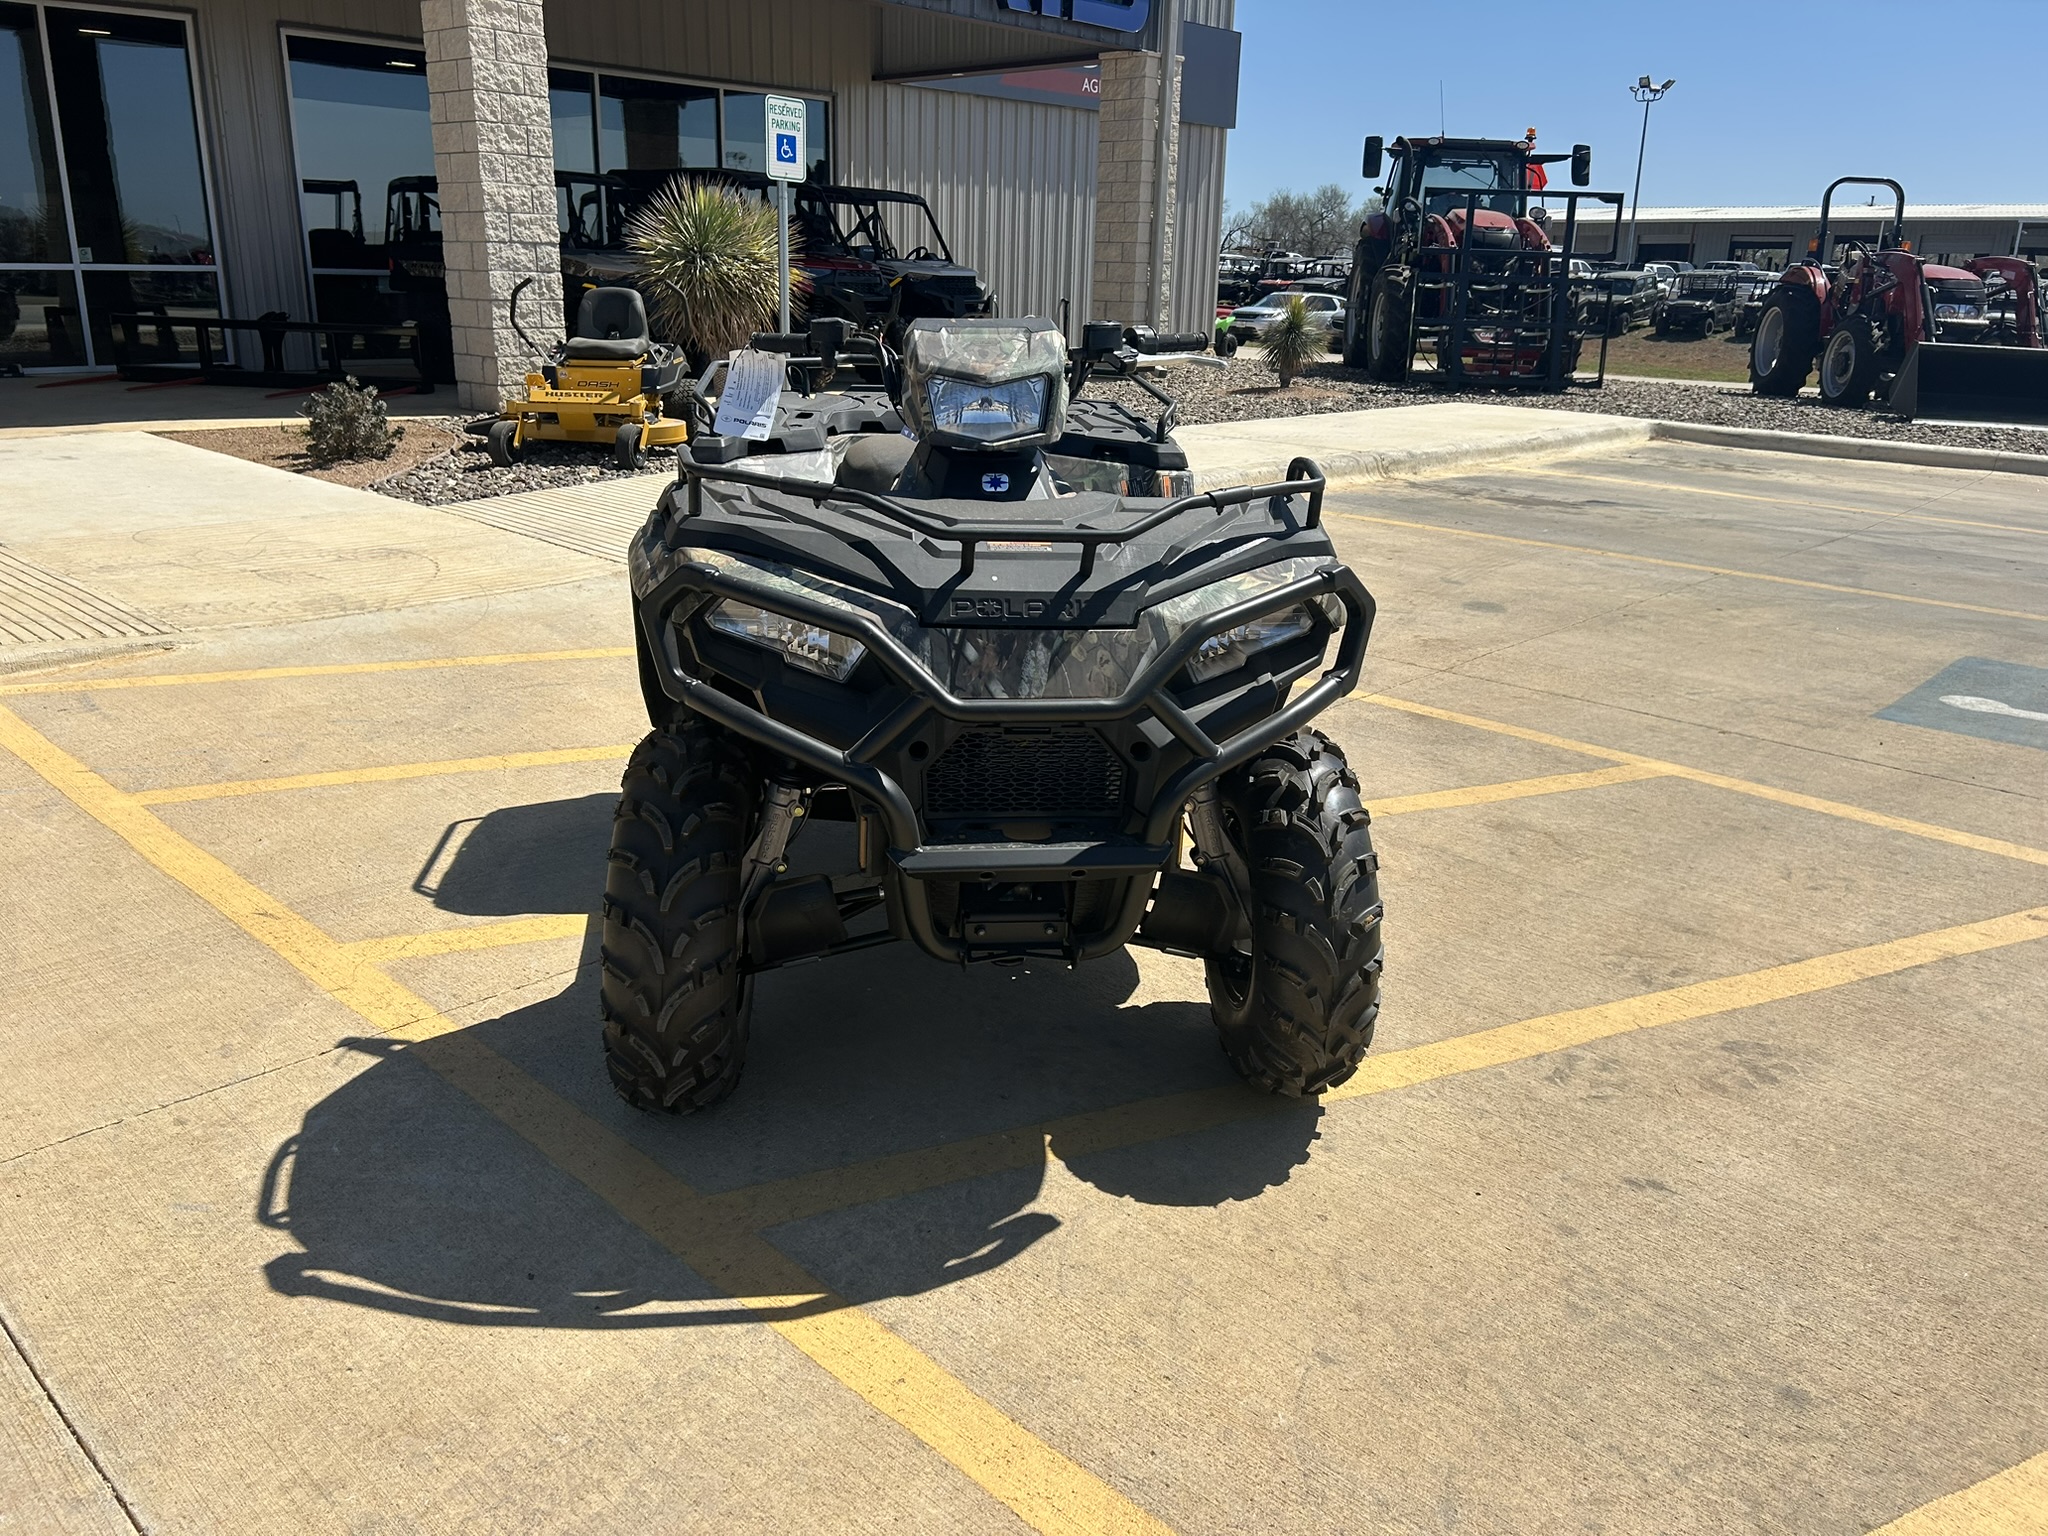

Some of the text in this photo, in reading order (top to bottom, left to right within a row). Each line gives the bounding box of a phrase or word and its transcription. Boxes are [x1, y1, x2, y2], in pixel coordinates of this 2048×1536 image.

[1081, 77, 1102, 94] AG
[769, 103, 803, 118] RESERVED
[771, 118, 801, 132] PARKING
[577, 380, 620, 388] DASH
[545, 391, 604, 399] HUSTLER
[733, 417, 768, 429] POLARIS
